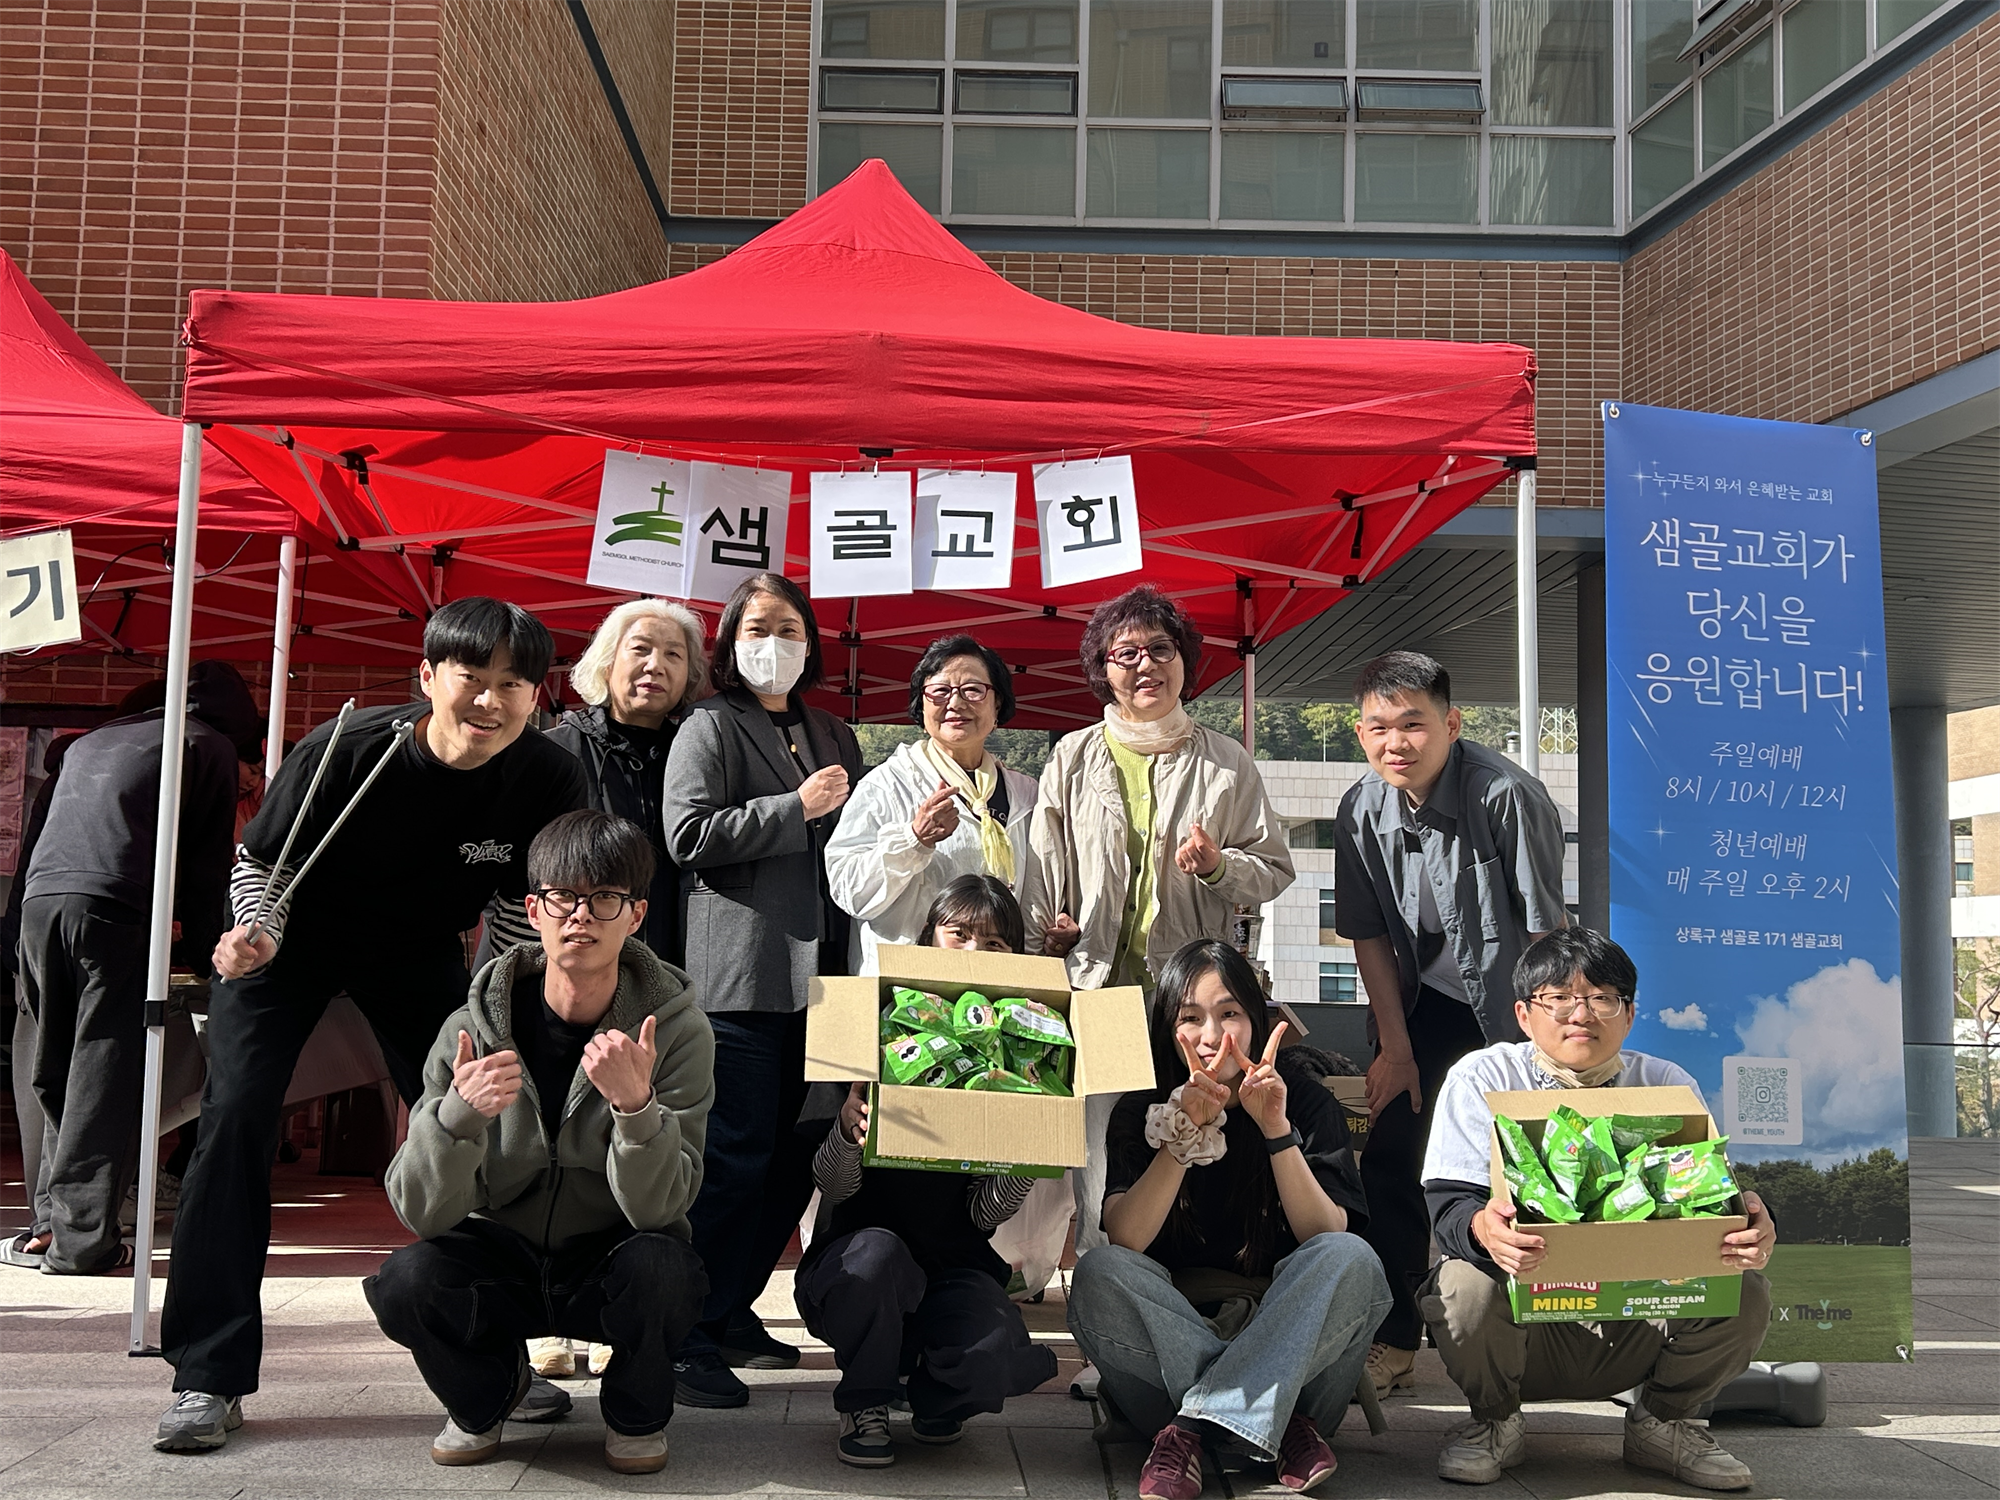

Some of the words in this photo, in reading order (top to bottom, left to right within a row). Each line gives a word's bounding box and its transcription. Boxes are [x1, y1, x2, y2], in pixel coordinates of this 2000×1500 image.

[1652, 471, 1709, 492] 누구든지
[1715, 477, 1742, 495] 와서
[1747, 480, 1803, 502] 은혜받는
[1806, 487, 1833, 504] 교회
[601, 550, 628, 560] SAEMGOL
[629, 555, 660, 565] METHODIST
[661, 560, 684, 568] CHURCH
[1640, 517, 1856, 584] 샘골교회가
[6, 559, 65, 622] 기
[1686, 588, 1816, 646] 당신을
[1636, 652, 1864, 717] 응원합니다!
[1709, 741, 1803, 772] 주일예배
[1665, 775, 1703, 803] 8시
[1727, 780, 1776, 807] 10시
[1798, 784, 1847, 811] 12시
[1709, 829, 1808, 862] 청년예배
[1666, 866, 1691, 894] 매
[1698, 869, 1748, 898] 주일
[1756, 872, 1806, 900] 오후
[1813, 875, 1851, 903] 2시
[1676, 927, 1717, 945] 상록구
[1720, 929, 1761, 946] 샘골로
[1764, 931, 1787, 946] 171
[1790, 932, 1844, 950] 샘골교회
[1532, 1297, 1597, 1312] MINIS
[1626, 1297, 1660, 1306] SOUR
[1662, 1295, 1706, 1304] CREAM
